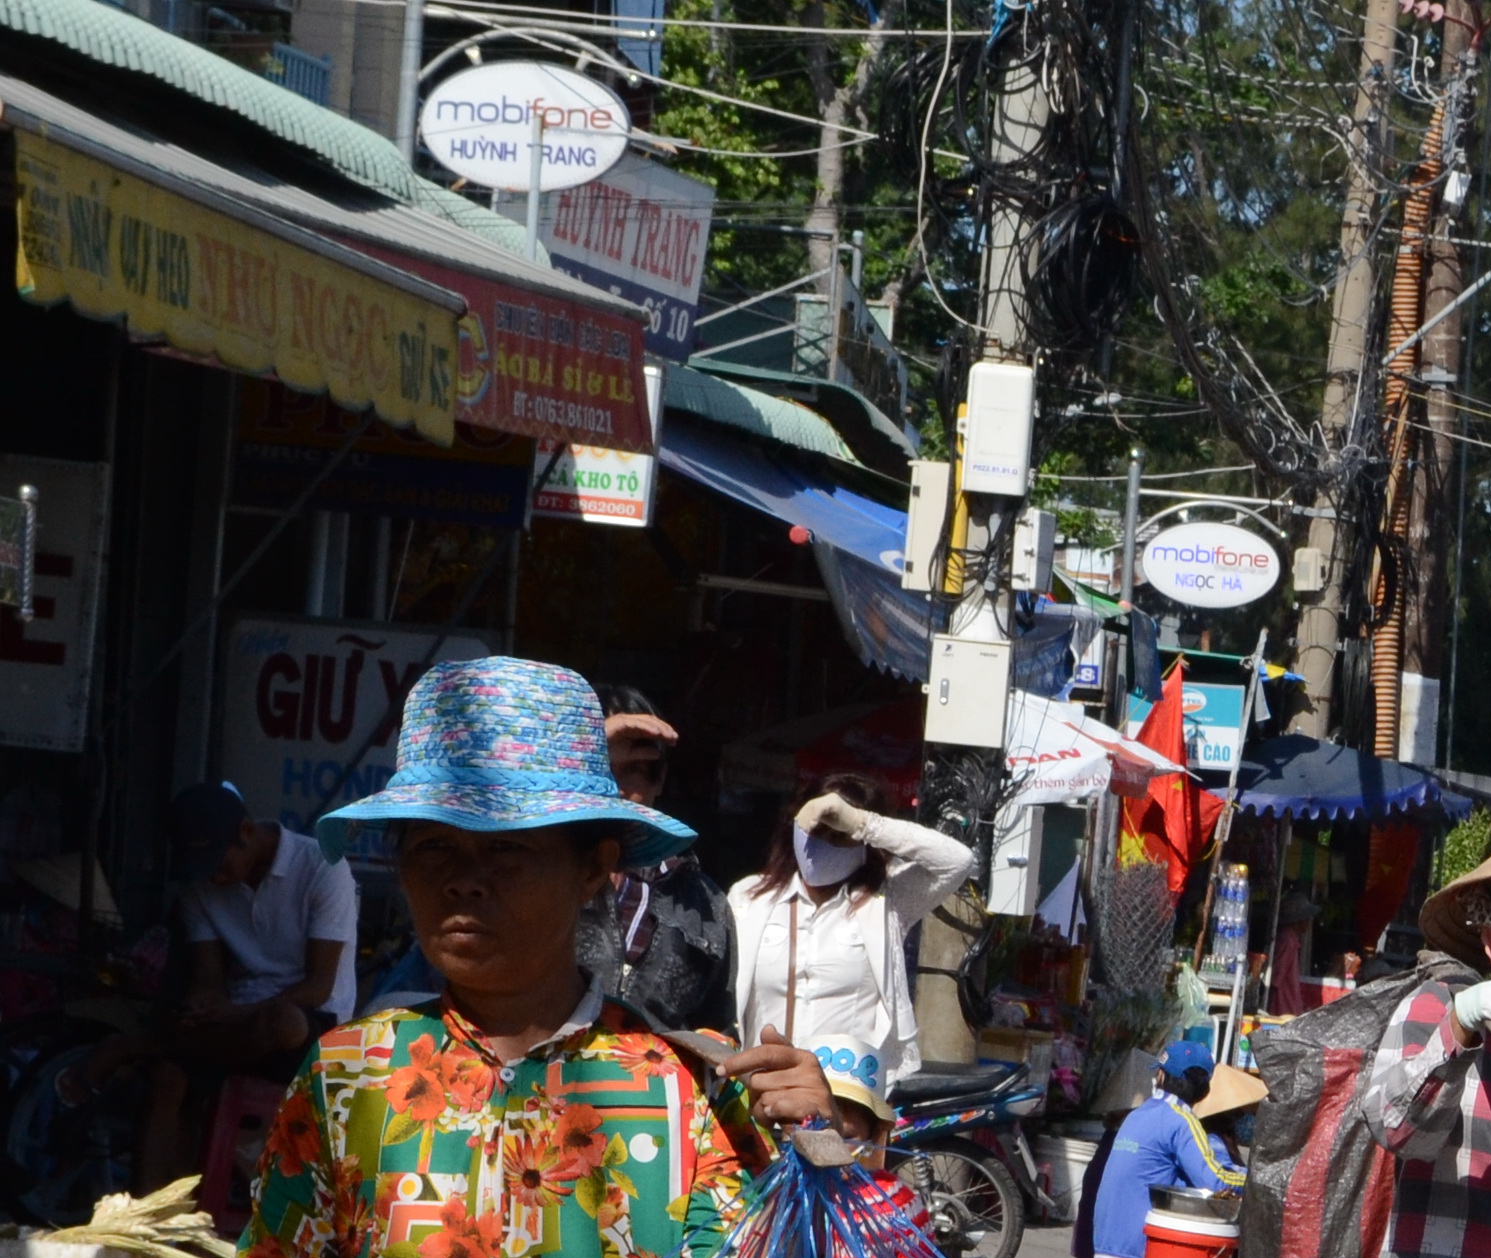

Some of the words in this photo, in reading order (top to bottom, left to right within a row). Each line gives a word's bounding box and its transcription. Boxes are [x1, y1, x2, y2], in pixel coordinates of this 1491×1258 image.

[436, 95, 612, 130] mobifone
[450, 135, 517, 163] HUỲNH
[667, 304, 689, 342] 10
[574, 469, 612, 491] KHO
[616, 471, 639, 498] TỘ
[569, 498, 637, 516] 3862060
[1151, 544, 1270, 569] mobifone
[1174, 572, 1216, 591] NGỌC
[1221, 571, 1243, 591] HÀ
[256, 633, 387, 744] GIỮ
[1202, 742, 1232, 763] CÀO
